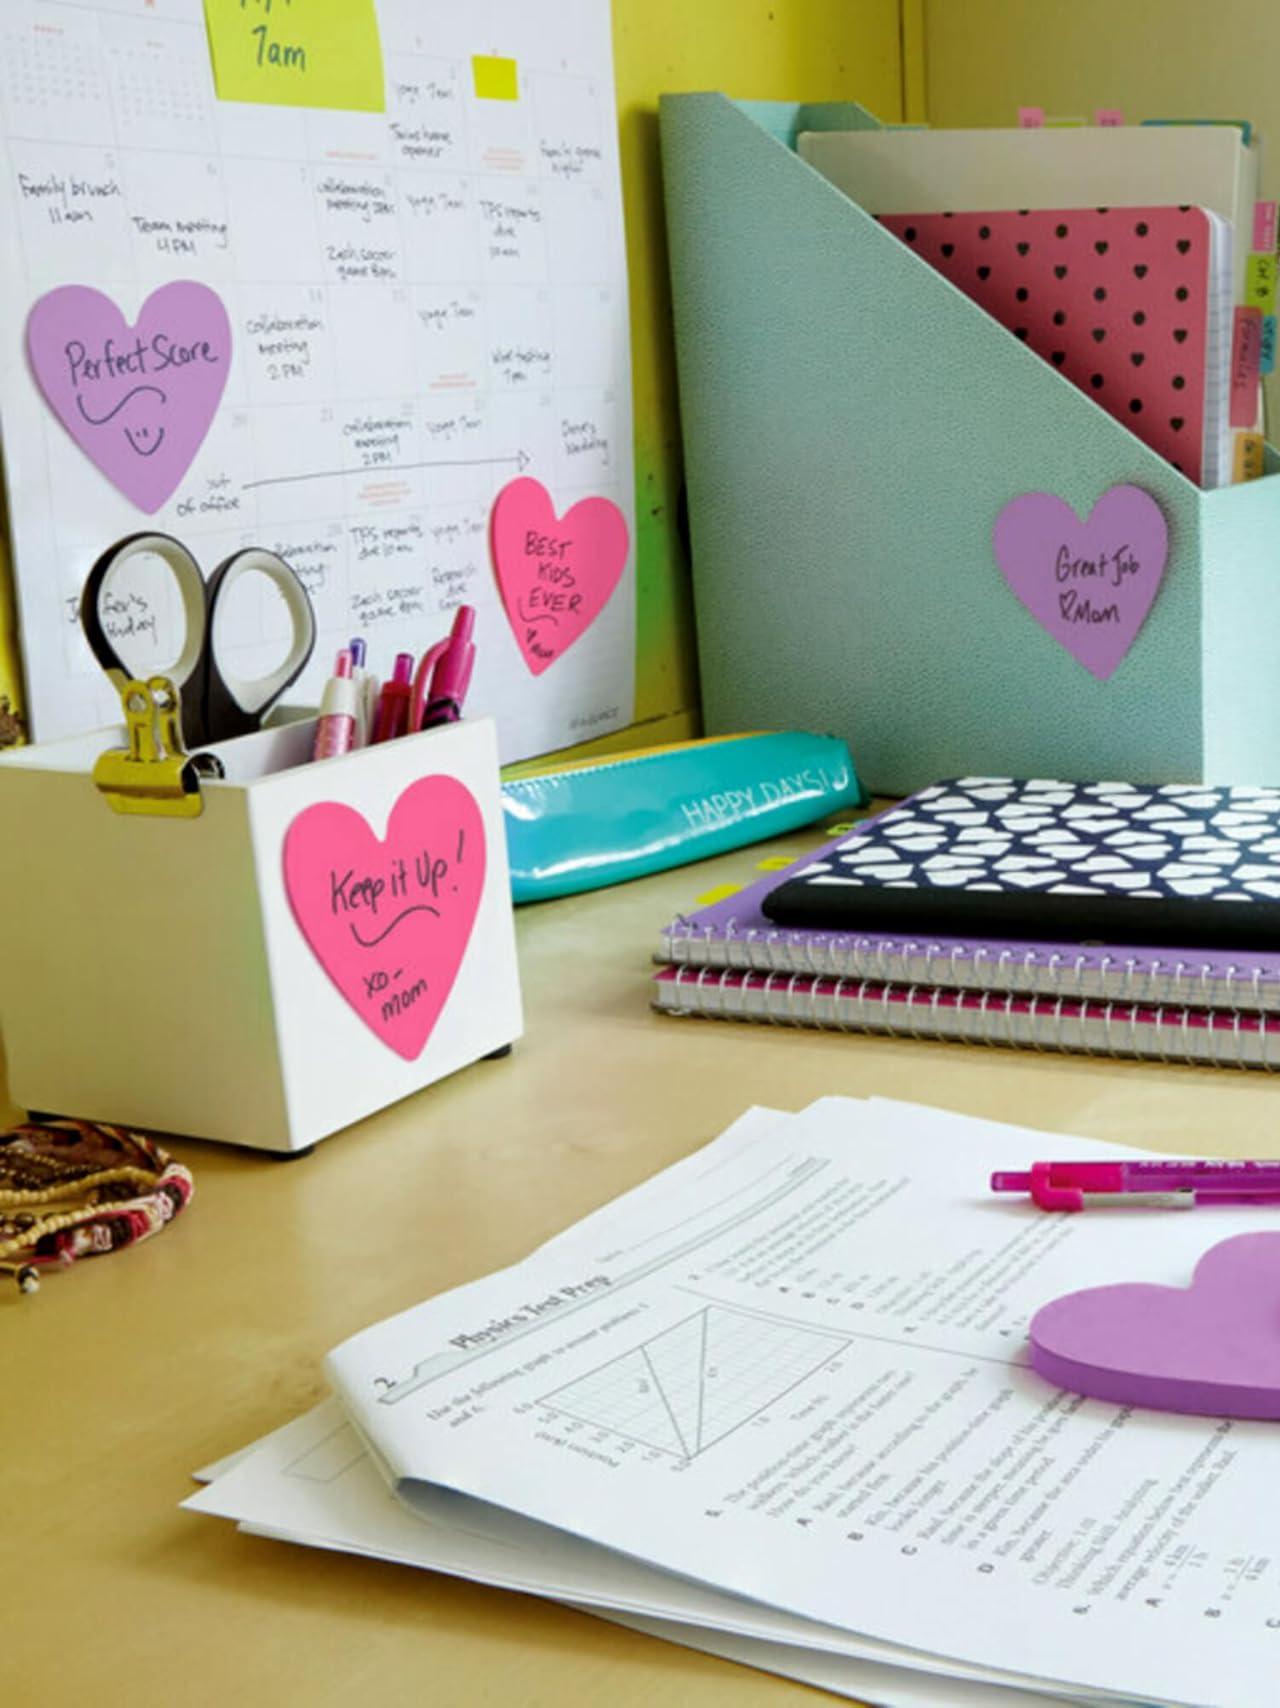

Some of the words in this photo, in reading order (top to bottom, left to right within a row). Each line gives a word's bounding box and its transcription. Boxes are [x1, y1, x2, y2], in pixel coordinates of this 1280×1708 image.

[251, 24, 306, 72] 7am
[19, 172, 67, 208] Family
[132, 215, 173, 233] Team
[65, 336, 149, 387] Perfect
[150, 334, 220, 372] Score
[524, 530, 574, 561] BEST
[1055, 543, 1109, 584] Great
[1110, 543, 1141, 587] Job
[538, 561, 577, 589] KIDS
[528, 586, 584, 615] EVER
[1073, 599, 1121, 624] Mom
[681, 786, 754, 828] HAPPY
[330, 869, 385, 915] Keep
[391, 857, 408, 897] it
[449, 1312, 530, 1350] Physics
[522, 1295, 566, 1318] Test
[560, 1274, 614, 1300] Prep
